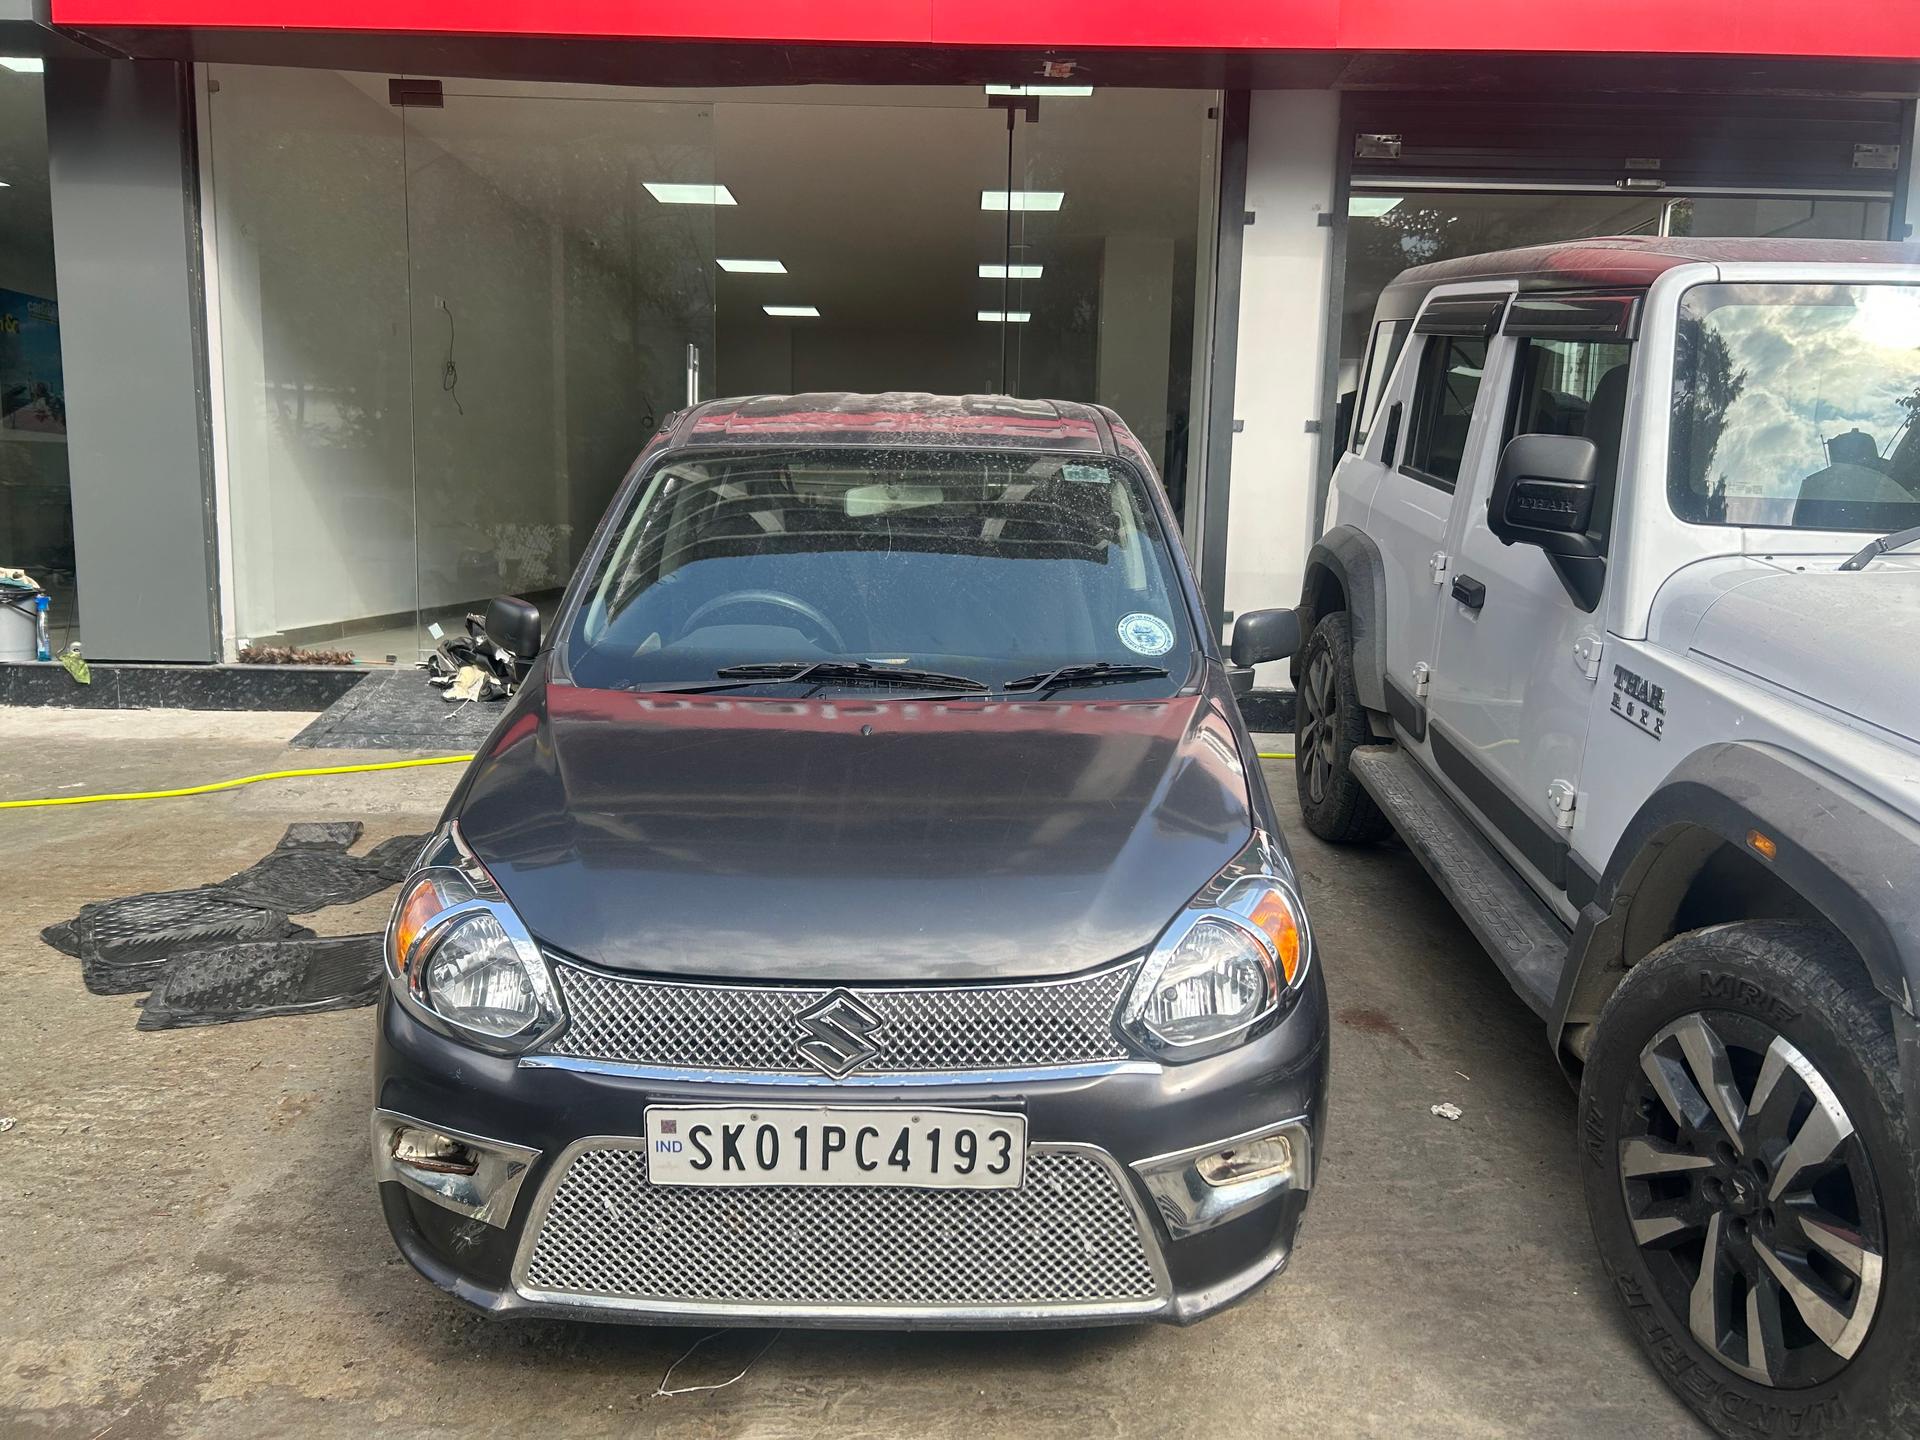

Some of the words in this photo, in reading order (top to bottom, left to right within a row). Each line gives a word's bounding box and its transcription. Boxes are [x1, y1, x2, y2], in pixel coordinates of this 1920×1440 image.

[1611, 691, 1664, 735] ROXX
[1613, 664, 1666, 716] THAR
[1697, 969, 1803, 1022] MRF
[655, 1140, 683, 1153] IND
[688, 1123, 1012, 1175] SK01PC4193
